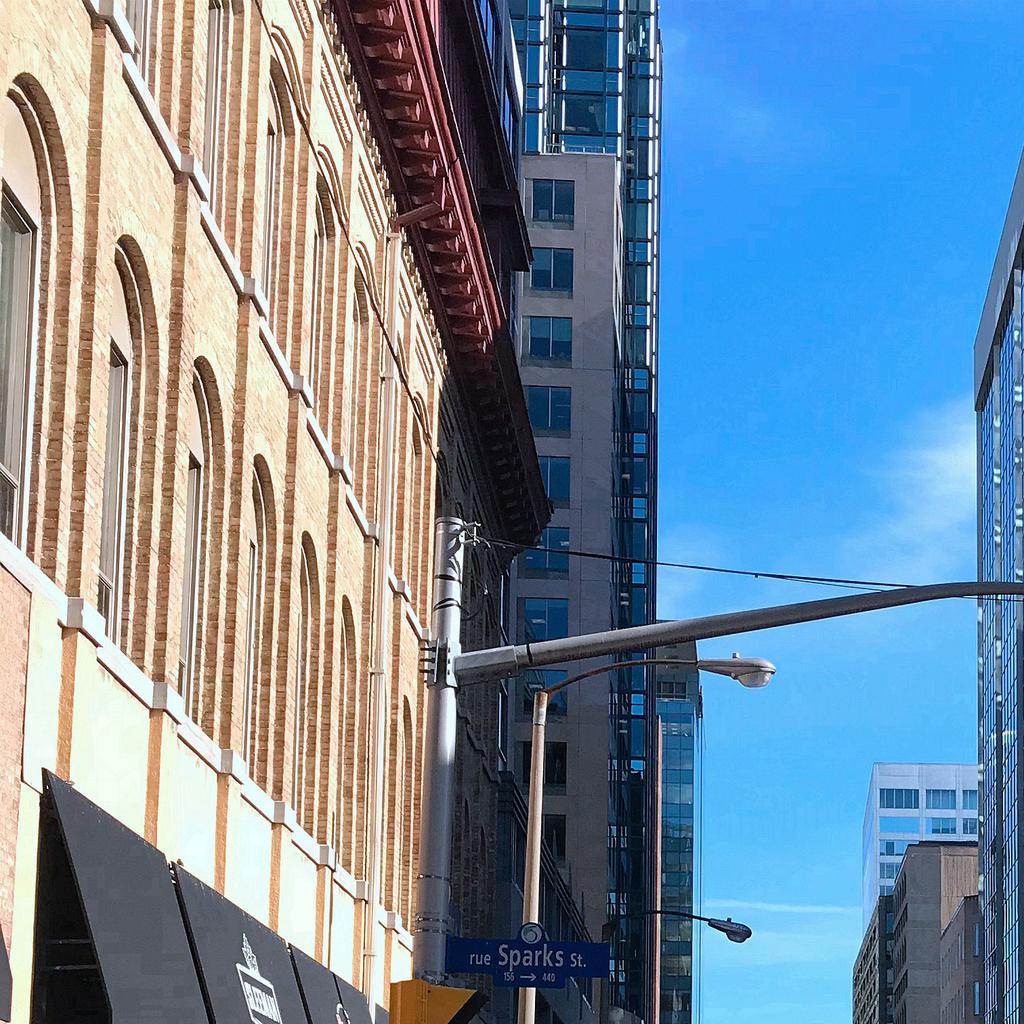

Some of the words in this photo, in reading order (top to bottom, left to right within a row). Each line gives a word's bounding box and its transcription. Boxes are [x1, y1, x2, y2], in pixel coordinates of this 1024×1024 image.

[470, 952, 491, 966] rue
[498, 943, 564, 971] Sparks
[570, 953, 587, 967] St.
[504, 972, 515, 981] 156
[542, 972, 556, 982] 440
